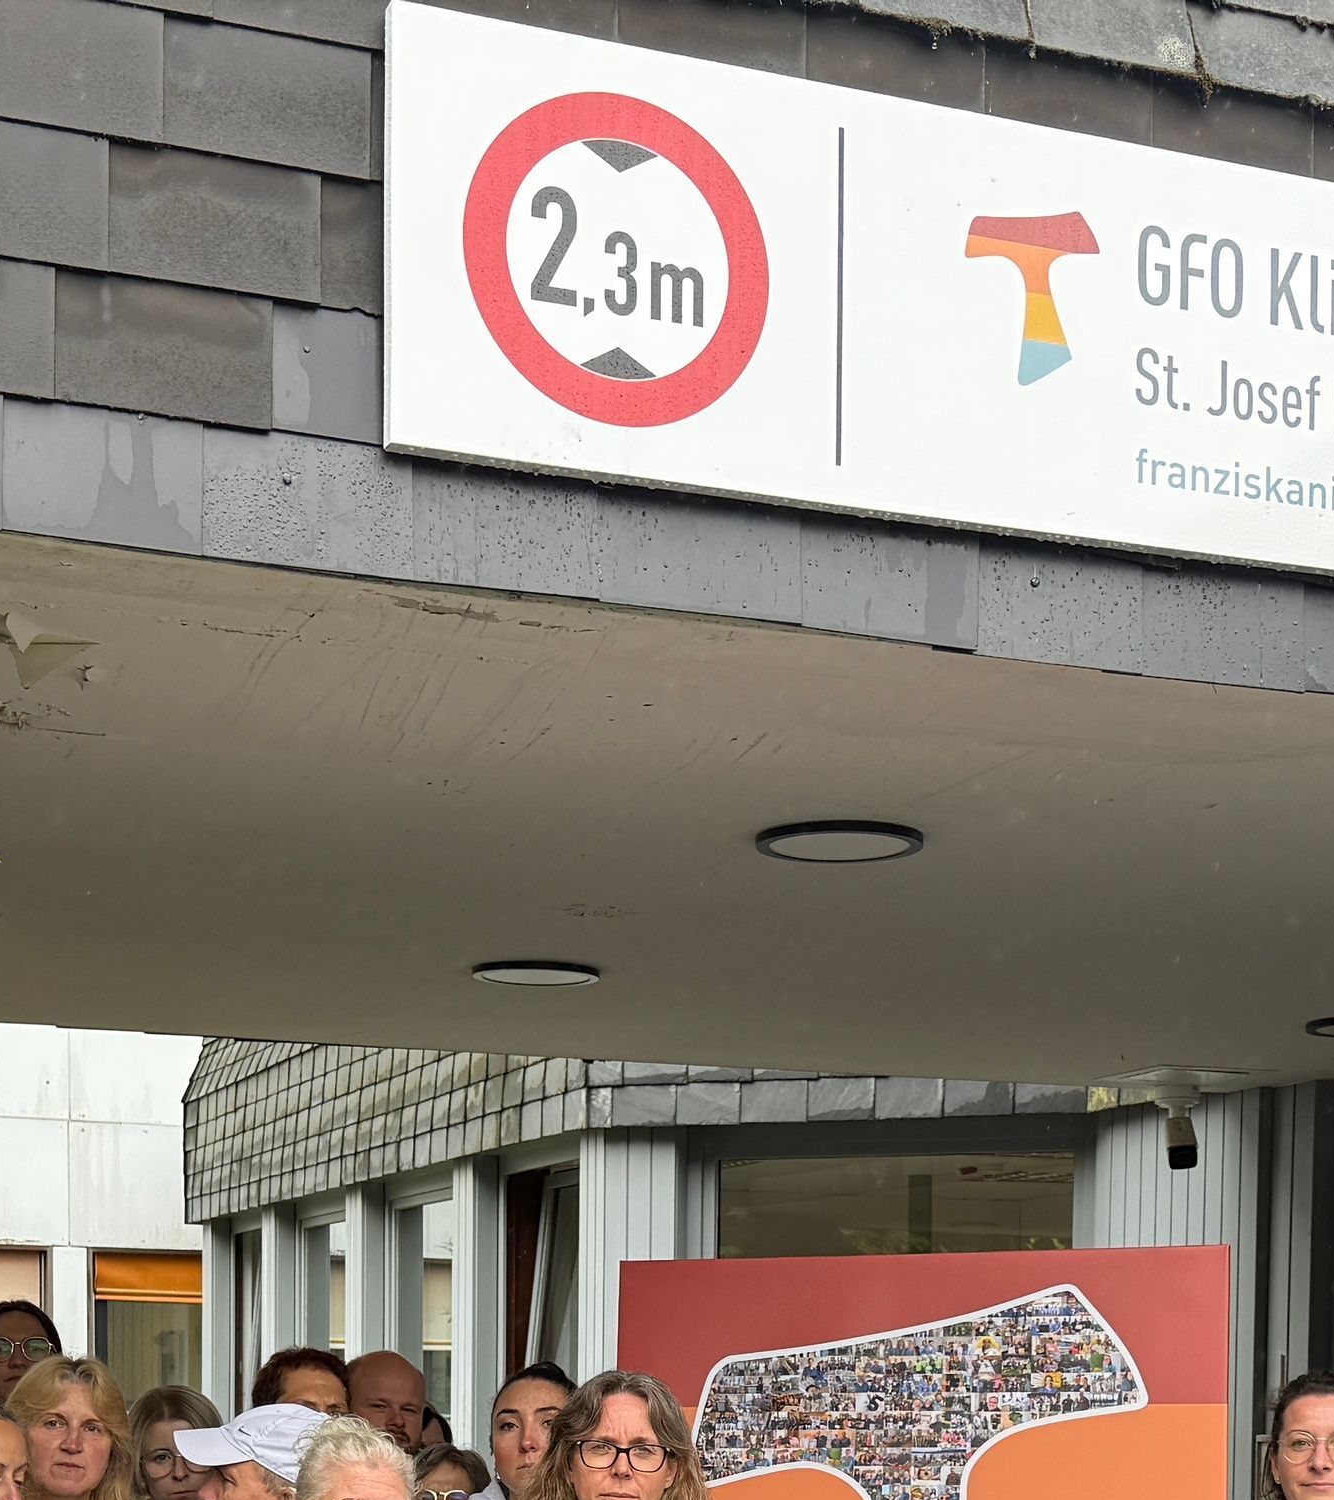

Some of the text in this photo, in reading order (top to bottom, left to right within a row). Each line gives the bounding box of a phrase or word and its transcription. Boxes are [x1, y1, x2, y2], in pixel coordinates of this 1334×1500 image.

[1135, 224, 1245, 319] GFO
[1134, 346, 1192, 413] St.
[1206, 359, 1322, 432] Josef
